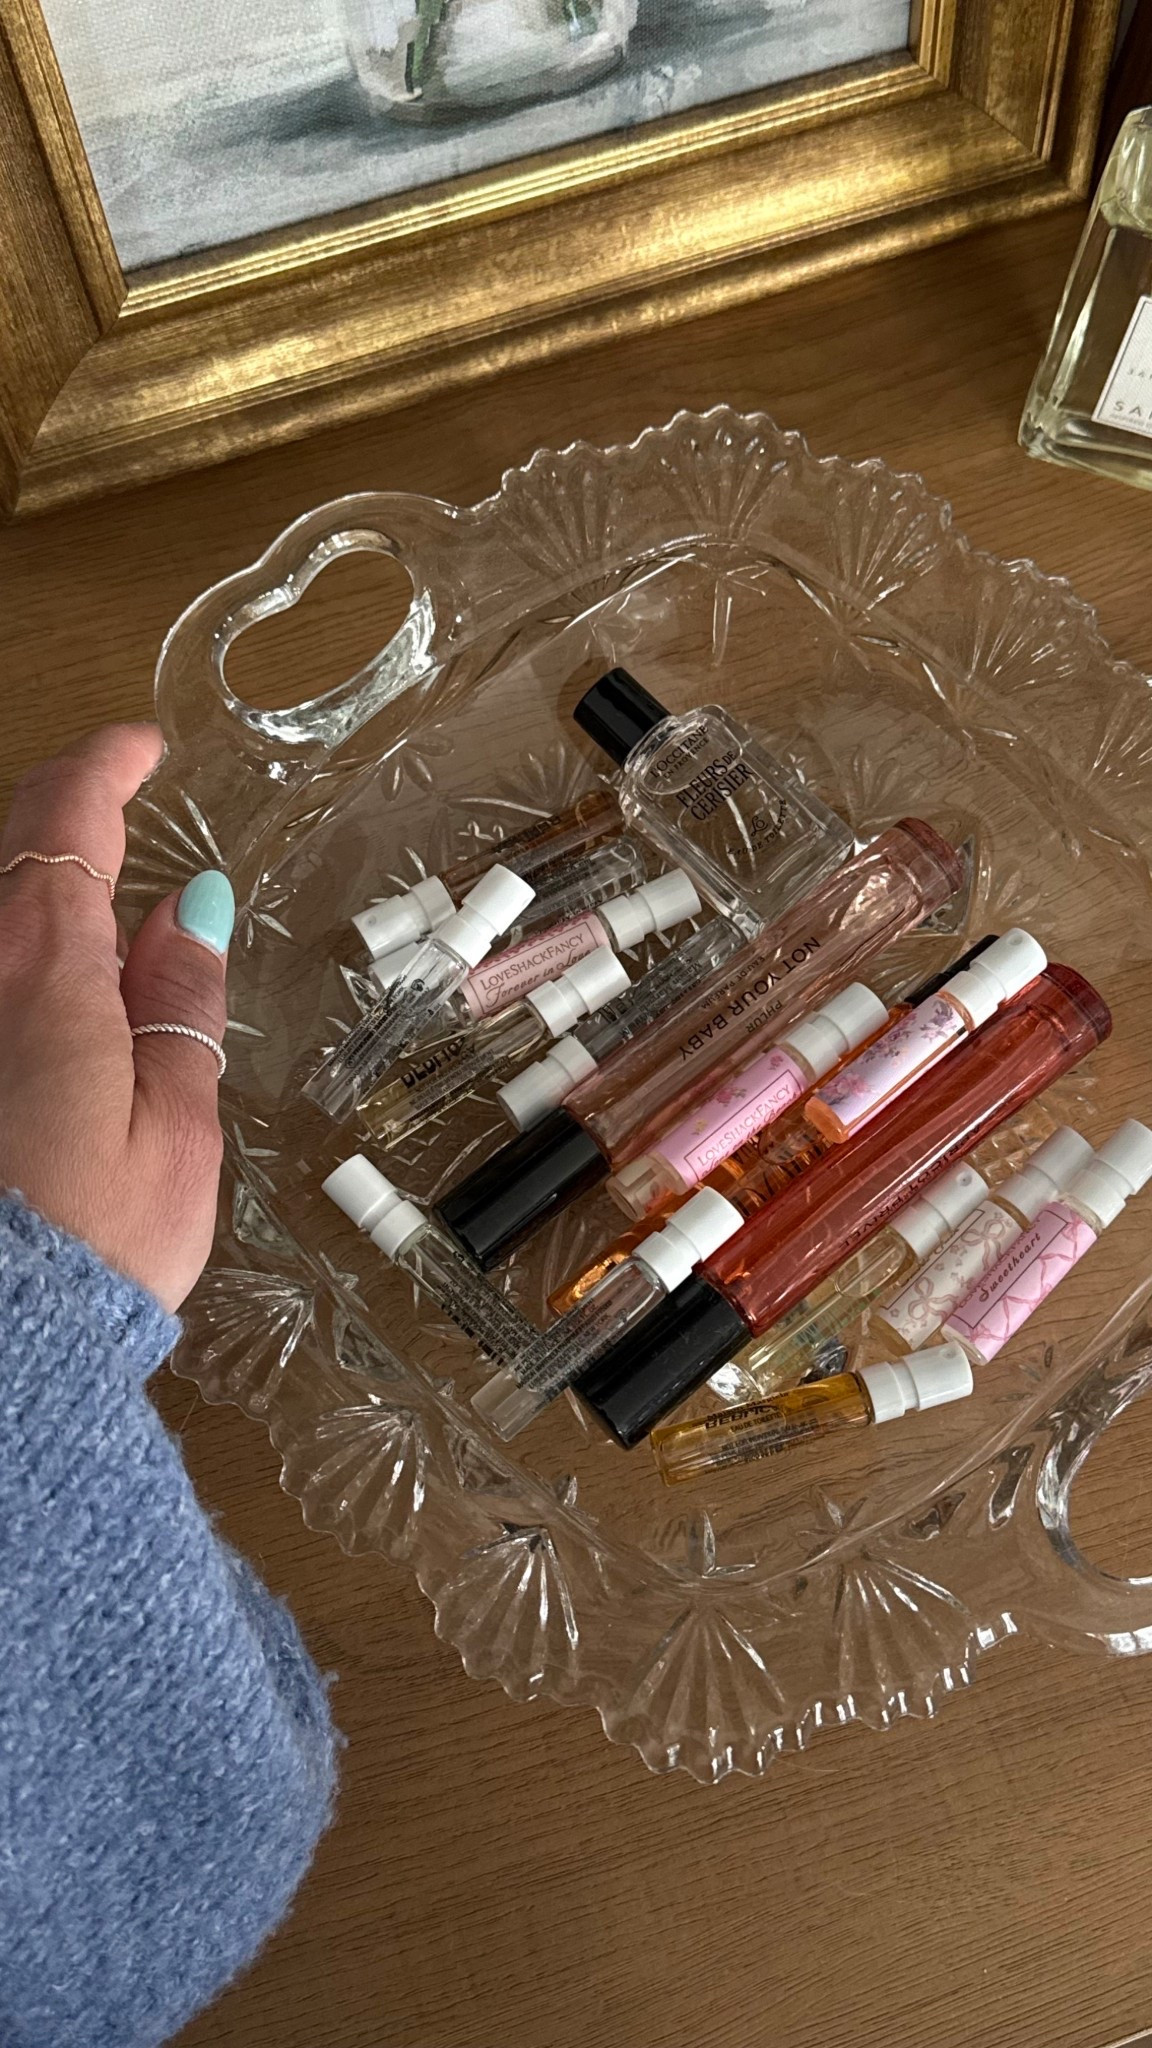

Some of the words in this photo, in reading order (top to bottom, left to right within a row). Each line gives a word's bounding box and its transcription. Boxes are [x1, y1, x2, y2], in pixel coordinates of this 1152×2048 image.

[663, 767, 675, 779] EN
[674, 736, 709, 769] PROVENCE
[675, 757, 728, 808] FLEURS
[722, 750, 736, 765] DE
[689, 761, 754, 822] CERISIER
[750, 841, 763, 851] DE
[764, 800, 785, 842] TOILETTE
[484, 974, 540, 1008] Forever
[542, 966, 554, 977] in
[557, 948, 591, 969] Love
[734, 969, 747, 981] DE
[746, 955, 765, 972] EAU
[779, 936, 820, 973] NOT
[700, 979, 735, 1010] PARFUM
[727, 969, 781, 1017] YOUR
[744, 1000, 782, 1033] PHLUR
[675, 1013, 728, 1060] BABY
[979, 1232, 1041, 1301] Sweetheart
